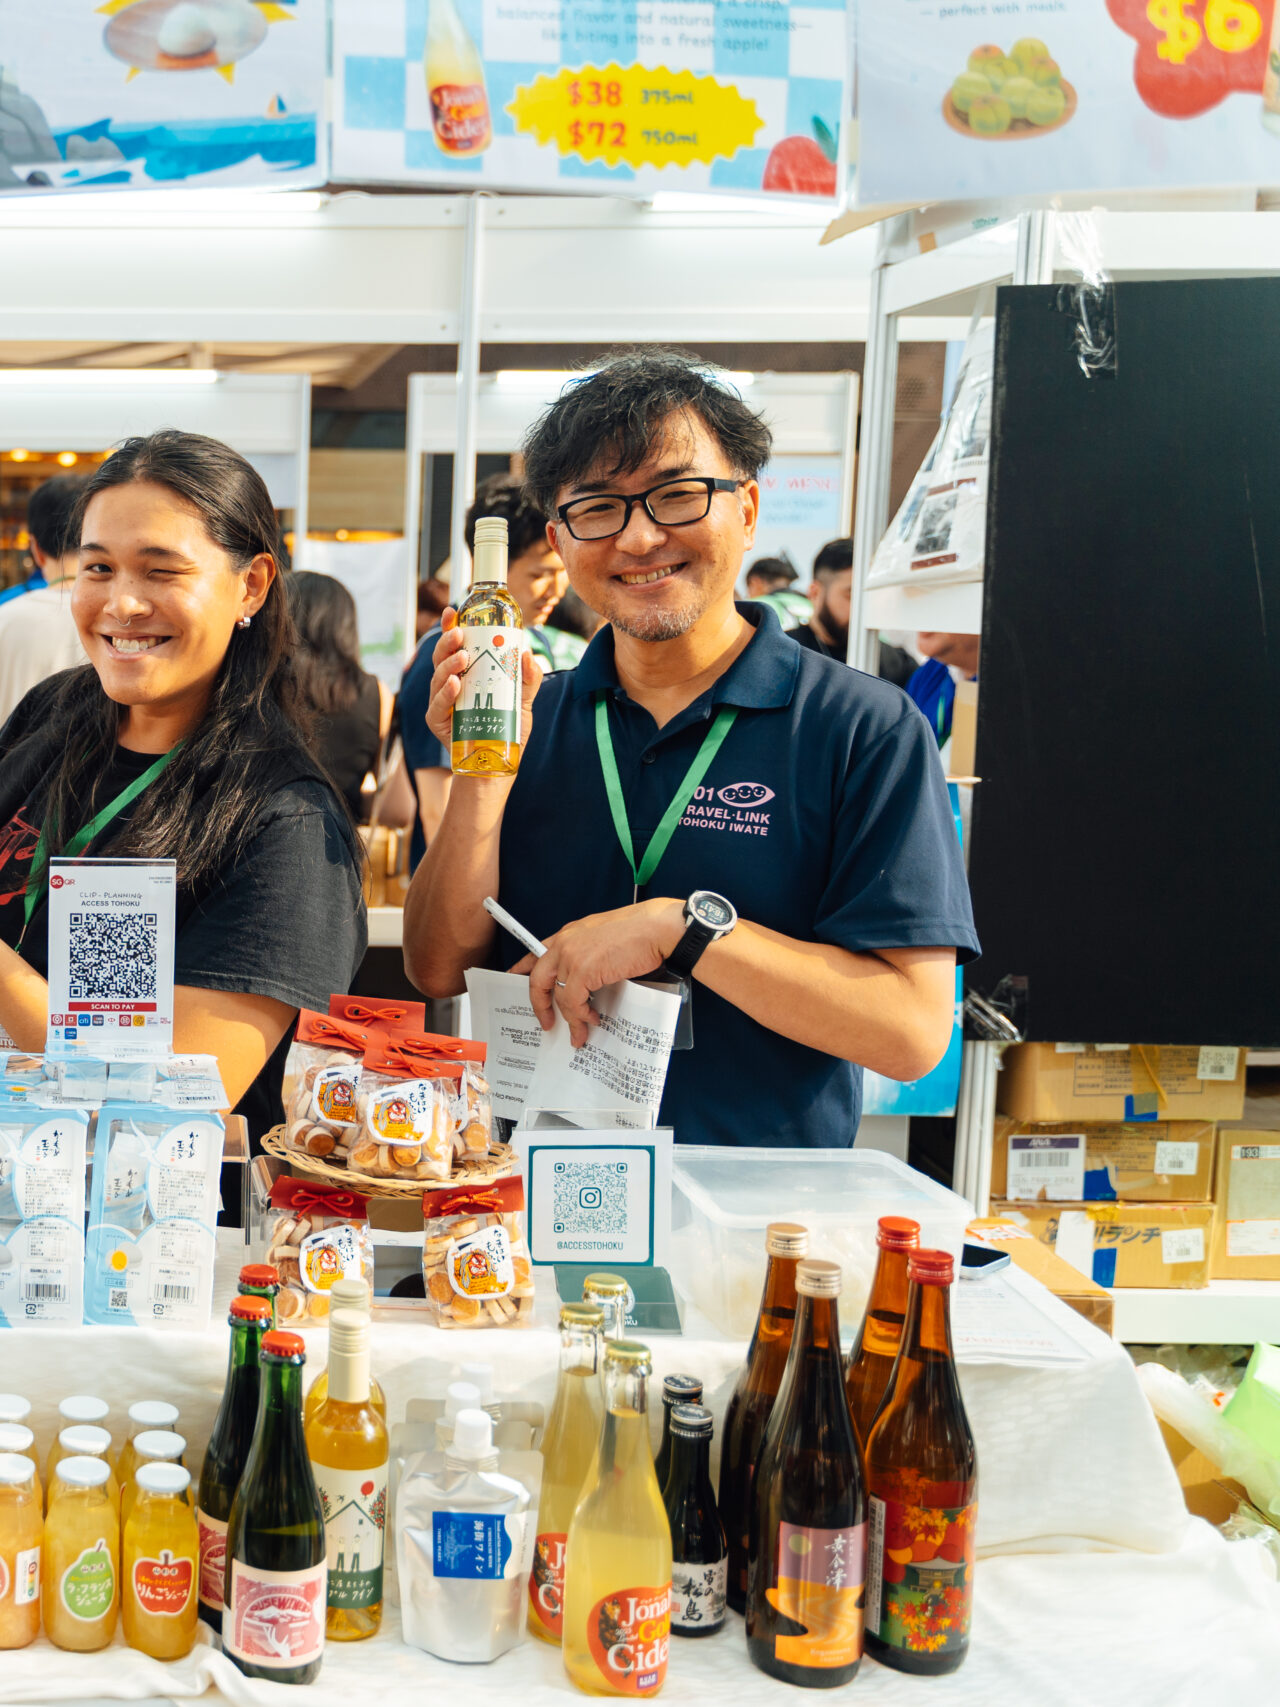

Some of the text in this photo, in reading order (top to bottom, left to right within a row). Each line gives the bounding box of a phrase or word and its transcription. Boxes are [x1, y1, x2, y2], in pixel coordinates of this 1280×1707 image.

[496, 7, 565, 21] balanced
[573, 8, 617, 24] flavor
[623, 11, 654, 25] and
[659, 11, 717, 28] natural
[939, 4, 989, 19] perfect
[992, 2, 1020, 15] with
[541, 28, 569, 42] like
[575, 29, 618, 47] biting
[624, 31, 655, 46] into
[677, 33, 717, 49] fresh
[722, 38, 770, 52] apple!
[1146, 0, 1263, 65] $6
[567, 80, 695, 109] $38 375ml
[567, 118, 700, 150] $72 750ml
[729, 823, 769, 837] IWATE
[79, 891, 98, 899] CLIP
[81, 900, 140, 908] ACCESS TOHOKU
[90, 1003, 136, 1011] SCAN TO PAY
[556, 1240, 624, 1251] @ACCESSTOHOKU
[137, 1582, 189, 1601] りんごジュース
[703, 1569, 717, 1598] 雪の
[76, 1591, 107, 1607] ジュース
[681, 1577, 704, 1623] 松島
